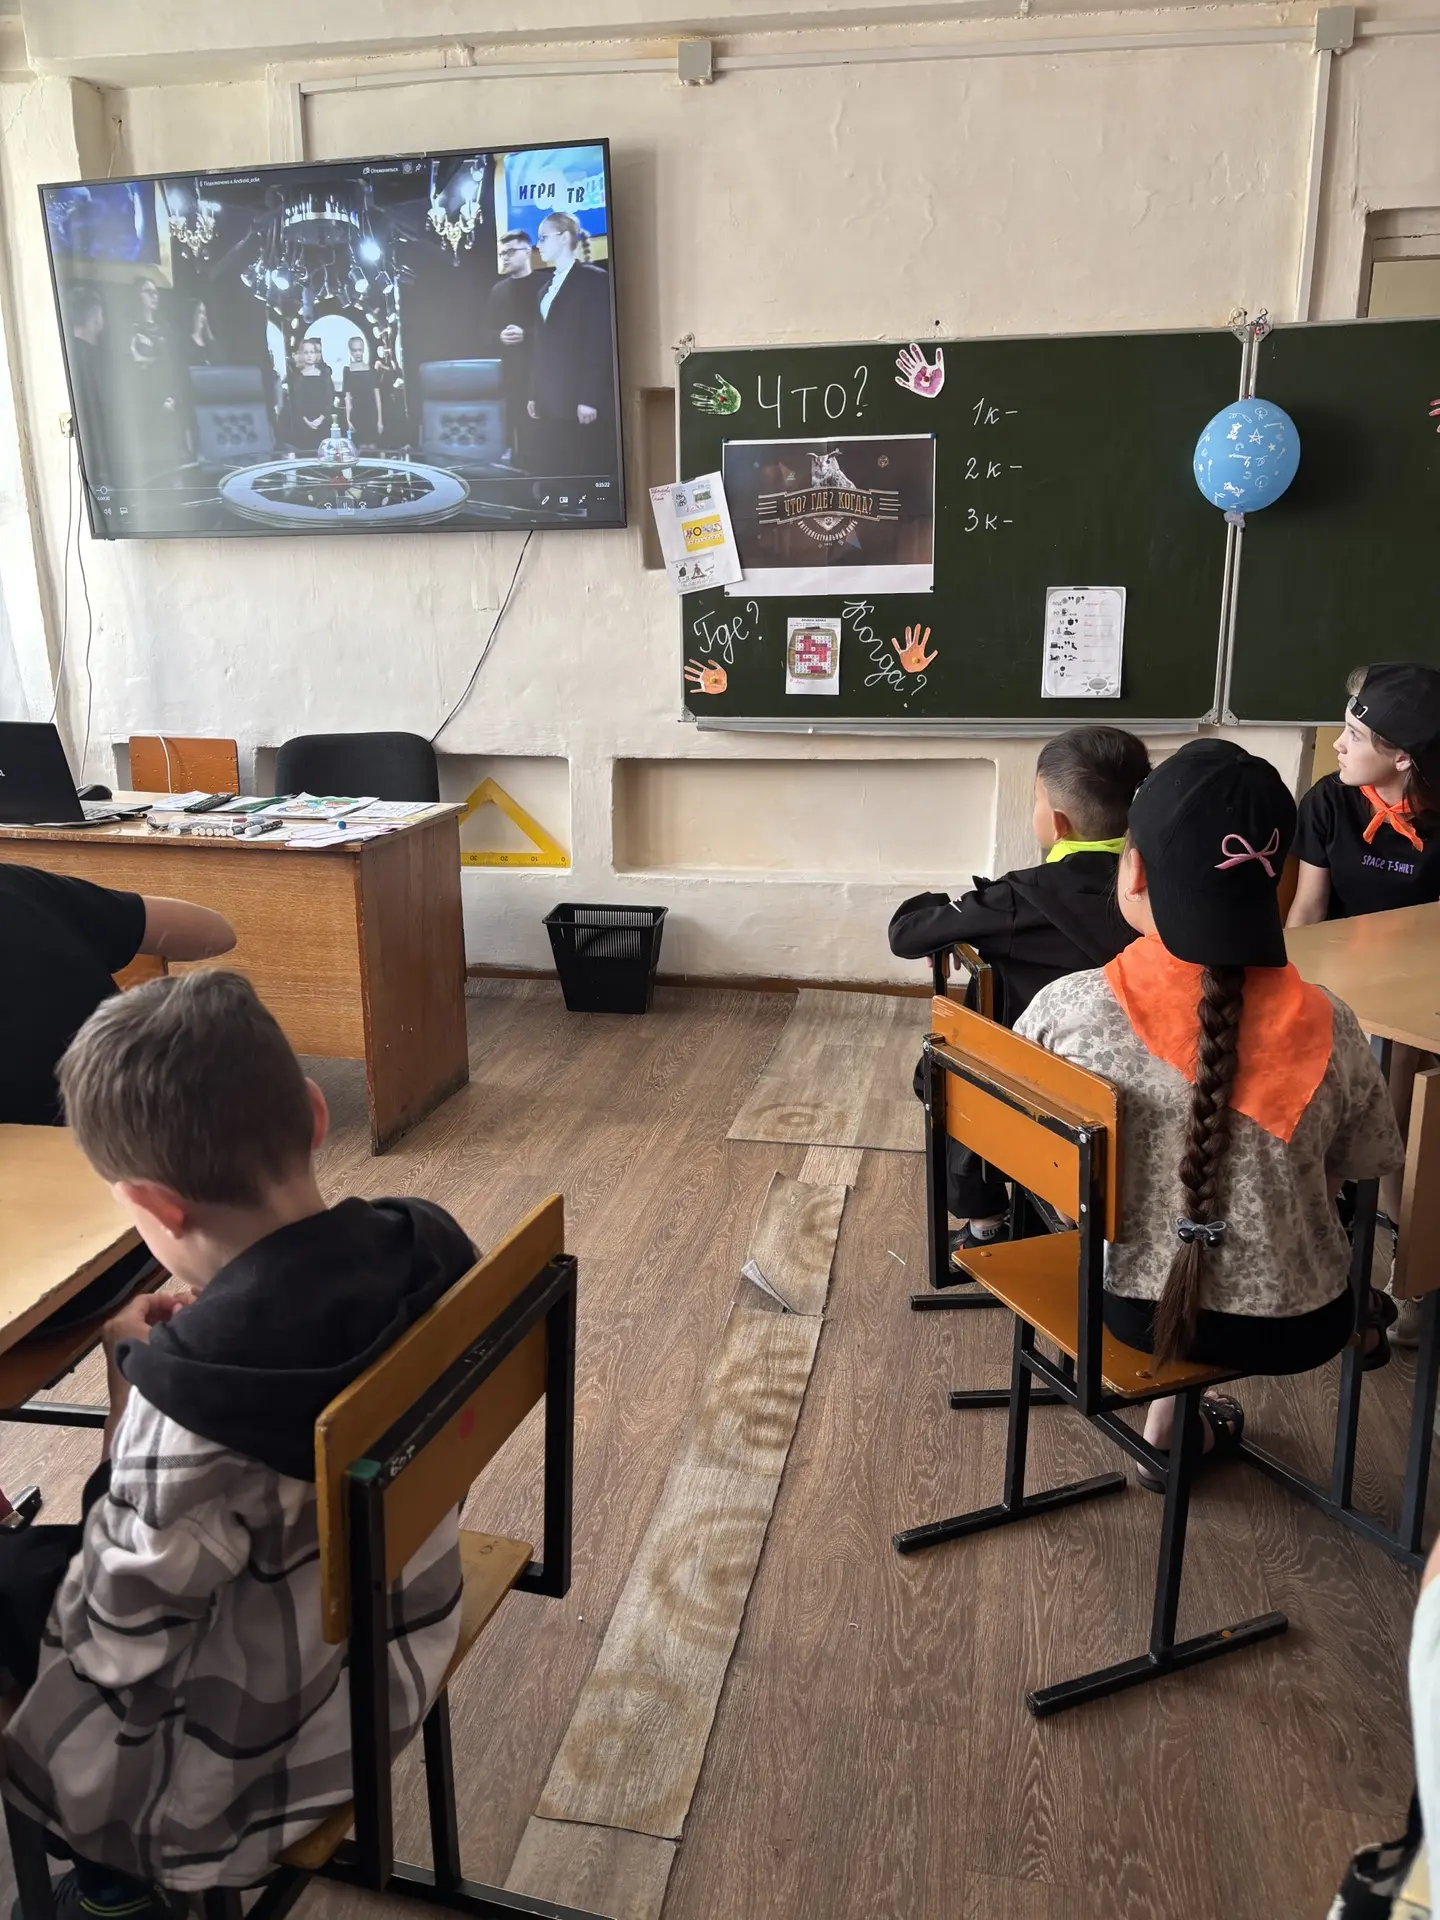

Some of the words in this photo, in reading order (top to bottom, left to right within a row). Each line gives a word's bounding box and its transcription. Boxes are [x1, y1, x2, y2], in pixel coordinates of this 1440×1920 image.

[519, 183, 556, 200] ИГРА
[566, 187, 585, 203] ТВ
[783, 495, 807, 516] ЧТО?
[810, 492, 834, 511] ГДЕ?
[838, 491, 873, 515] КОГДА?
[1387, 860, 1415, 874] T-SHIRT
